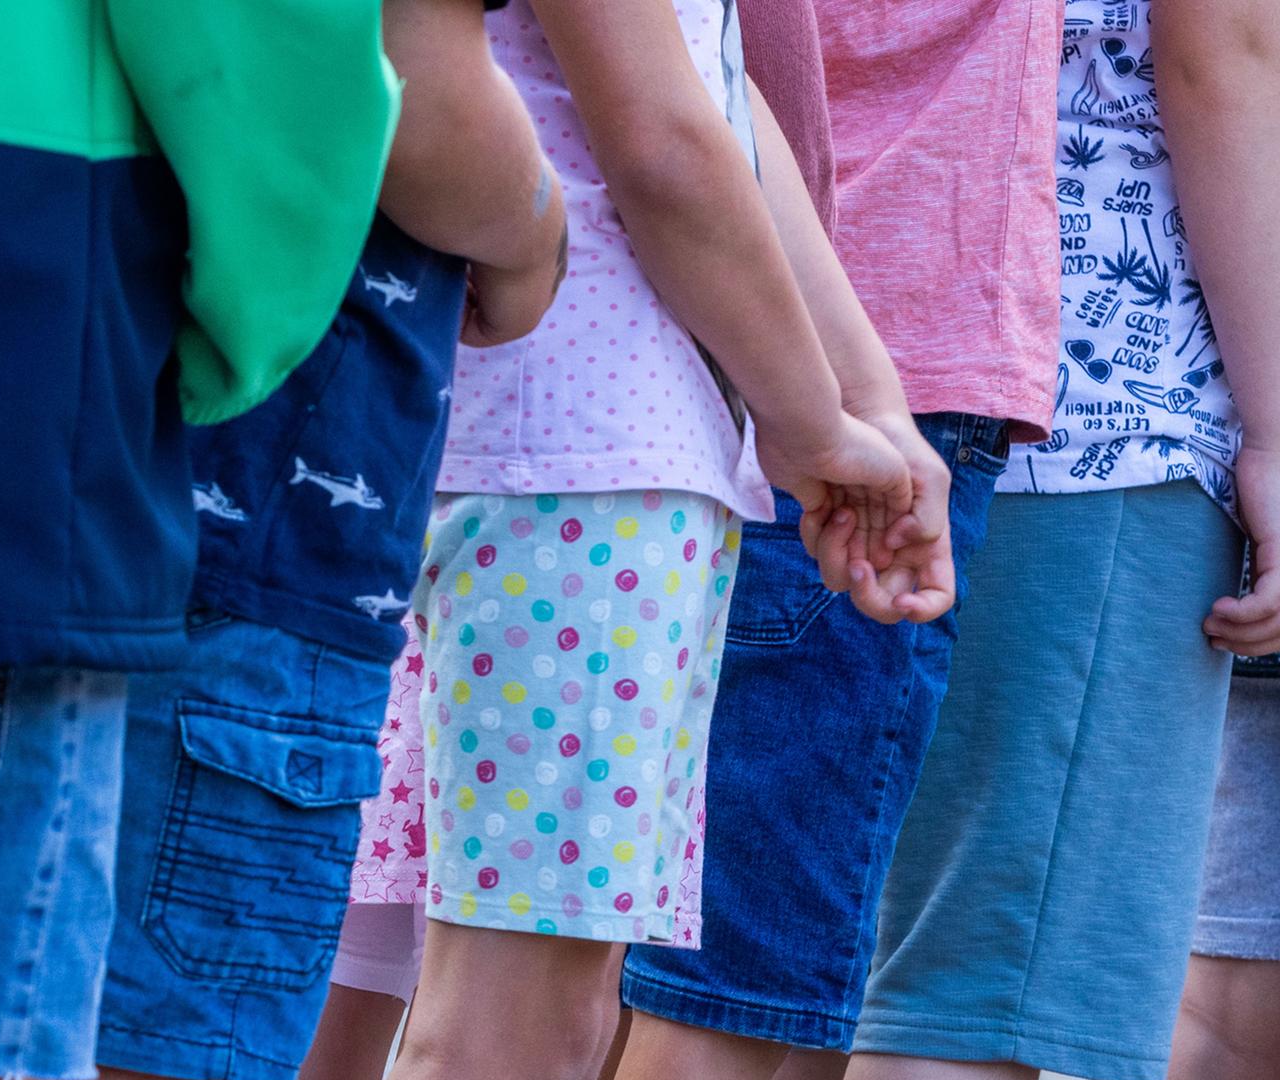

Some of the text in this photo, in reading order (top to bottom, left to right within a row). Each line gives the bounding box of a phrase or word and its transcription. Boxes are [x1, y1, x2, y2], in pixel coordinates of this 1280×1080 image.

[1061, 43, 1082, 66] P!
[1116, 178, 1151, 200] UP!
[1102, 197, 1154, 216] SURFS
[1059, 213, 1091, 234] UN
[1060, 237, 1086, 251] ND
[1062, 255, 1098, 276] ND
[1126, 334, 1163, 353] AND
[1111, 346, 1160, 374] SUN
[1082, 417, 1150, 432] LET'S GO
[1070, 442, 1106, 480] VIBES
